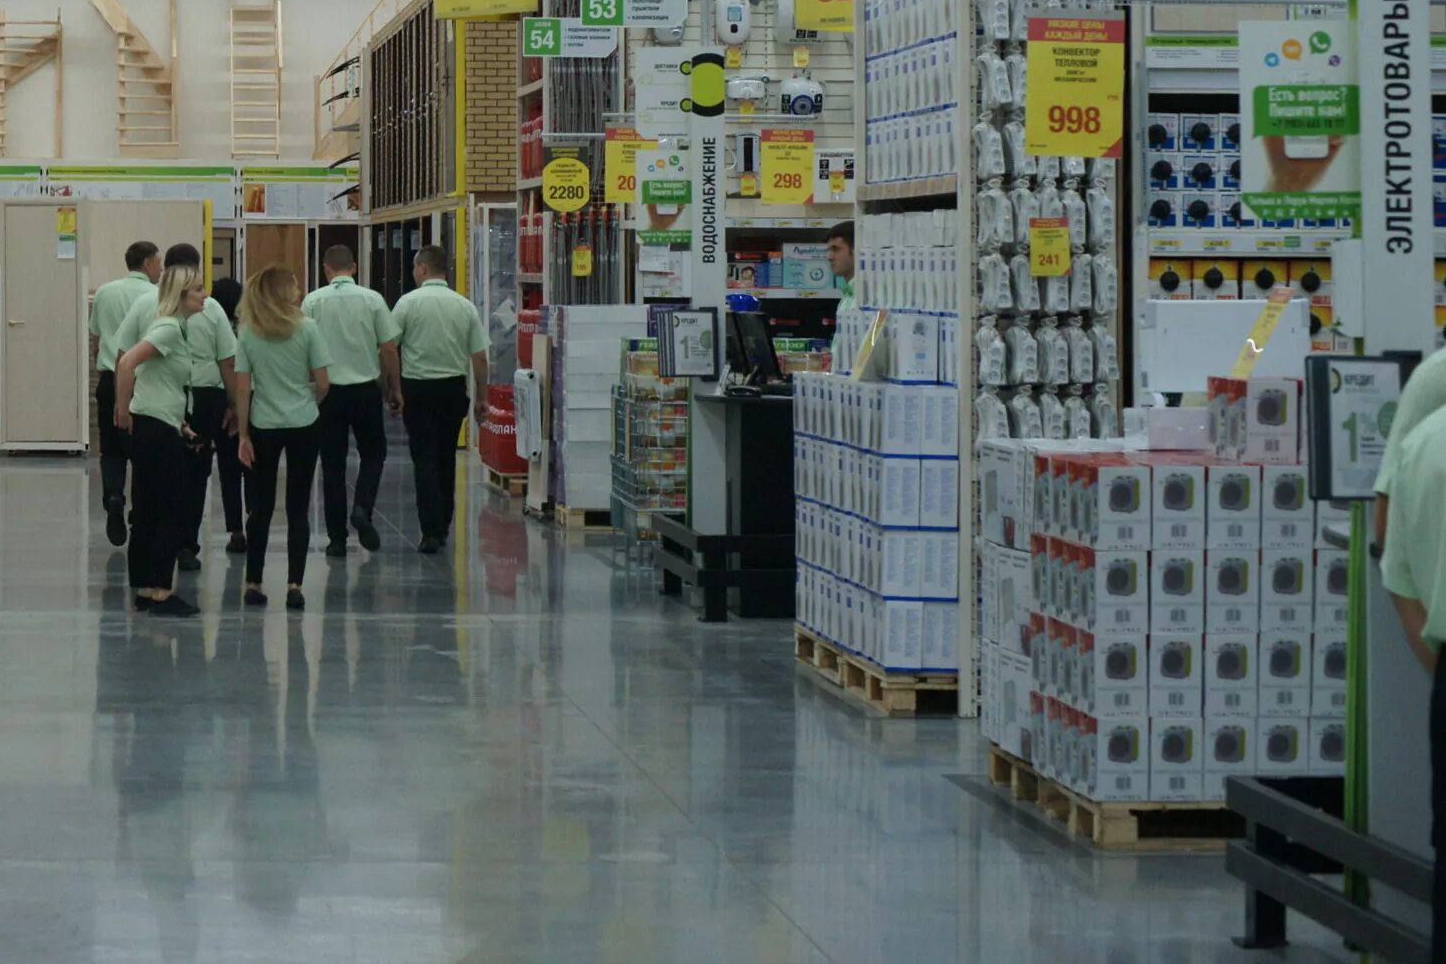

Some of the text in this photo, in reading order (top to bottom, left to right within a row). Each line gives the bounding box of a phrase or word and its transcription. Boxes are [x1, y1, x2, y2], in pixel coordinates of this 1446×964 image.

[530, 29, 555, 49] 54
[1052, 48, 1101, 56] КОНВЕКТОР
[1055, 58, 1098, 67] ТЕПЛОВОЙ
[1268, 87, 1347, 104] Есть вопрос?
[1269, 103, 1347, 116] Пишите нам!
[1048, 105, 1101, 134] 998
[773, 173, 802, 189] 298
[549, 185, 584, 200] 2280
[702, 137, 717, 264] ВОДОСНАБЖЕНИЕ
[1038, 254, 1060, 266] 241
